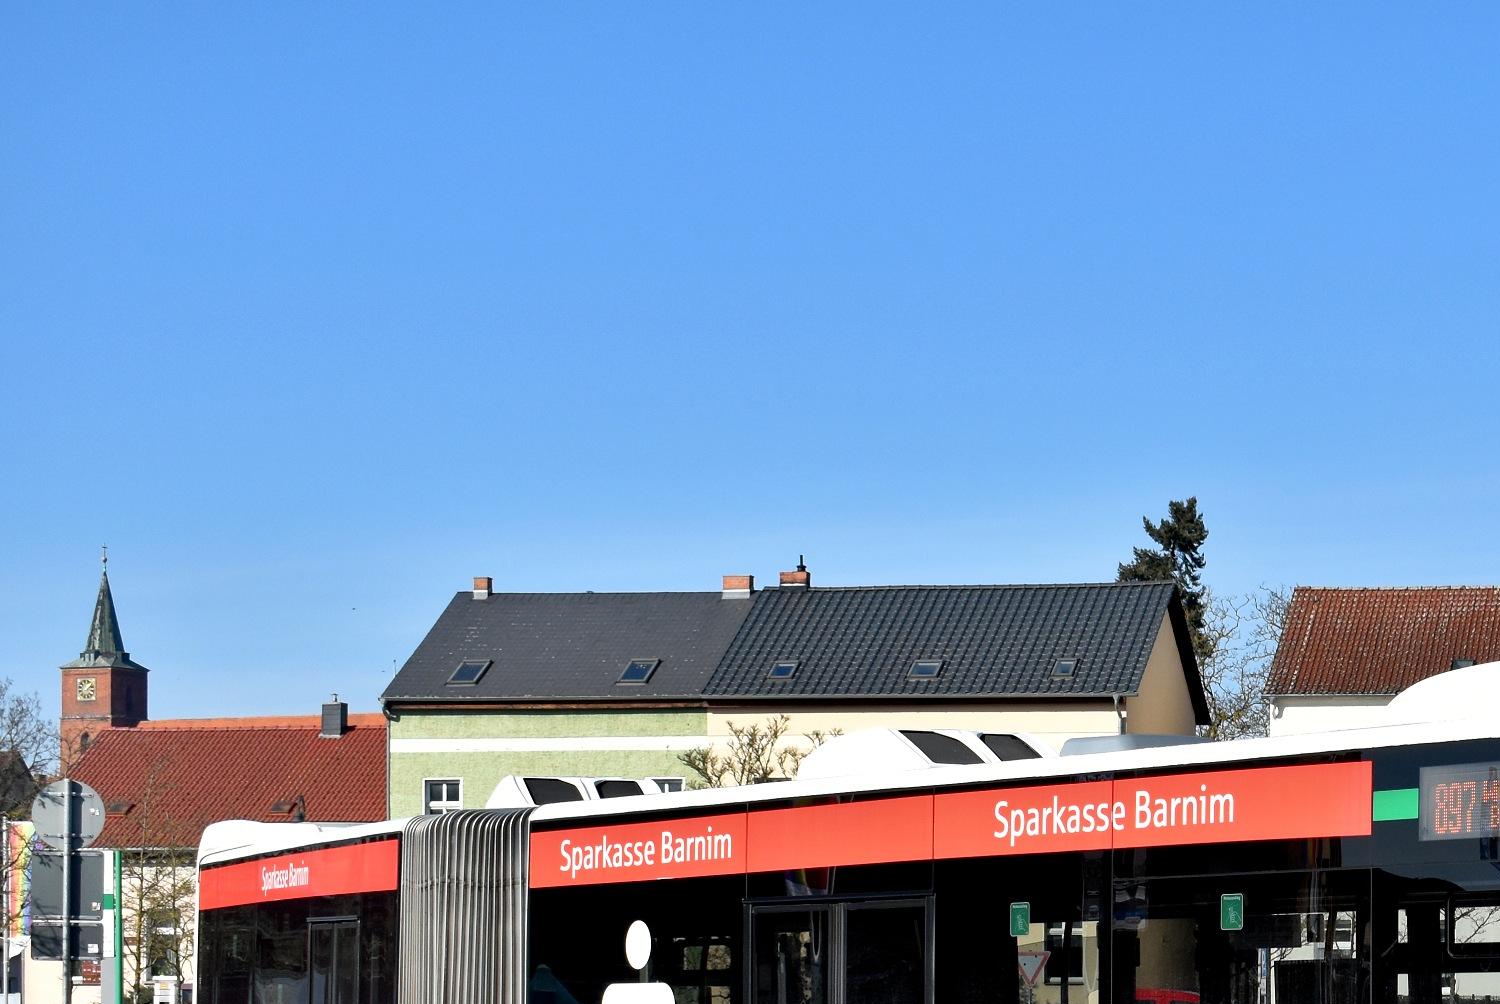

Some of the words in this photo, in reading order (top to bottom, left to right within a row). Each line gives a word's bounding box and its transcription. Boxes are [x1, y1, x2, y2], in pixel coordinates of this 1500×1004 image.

[994, 795, 1126, 847] Sparkasse
[1135, 784, 1235, 829] Barnim
[1434, 783, 1476, 834] 897
[262, 864, 289, 896] Sparkasse
[289, 859, 309, 887] Barnim
[560, 835, 656, 879] Sparkasse
[661, 825, 732, 864] Barnim
